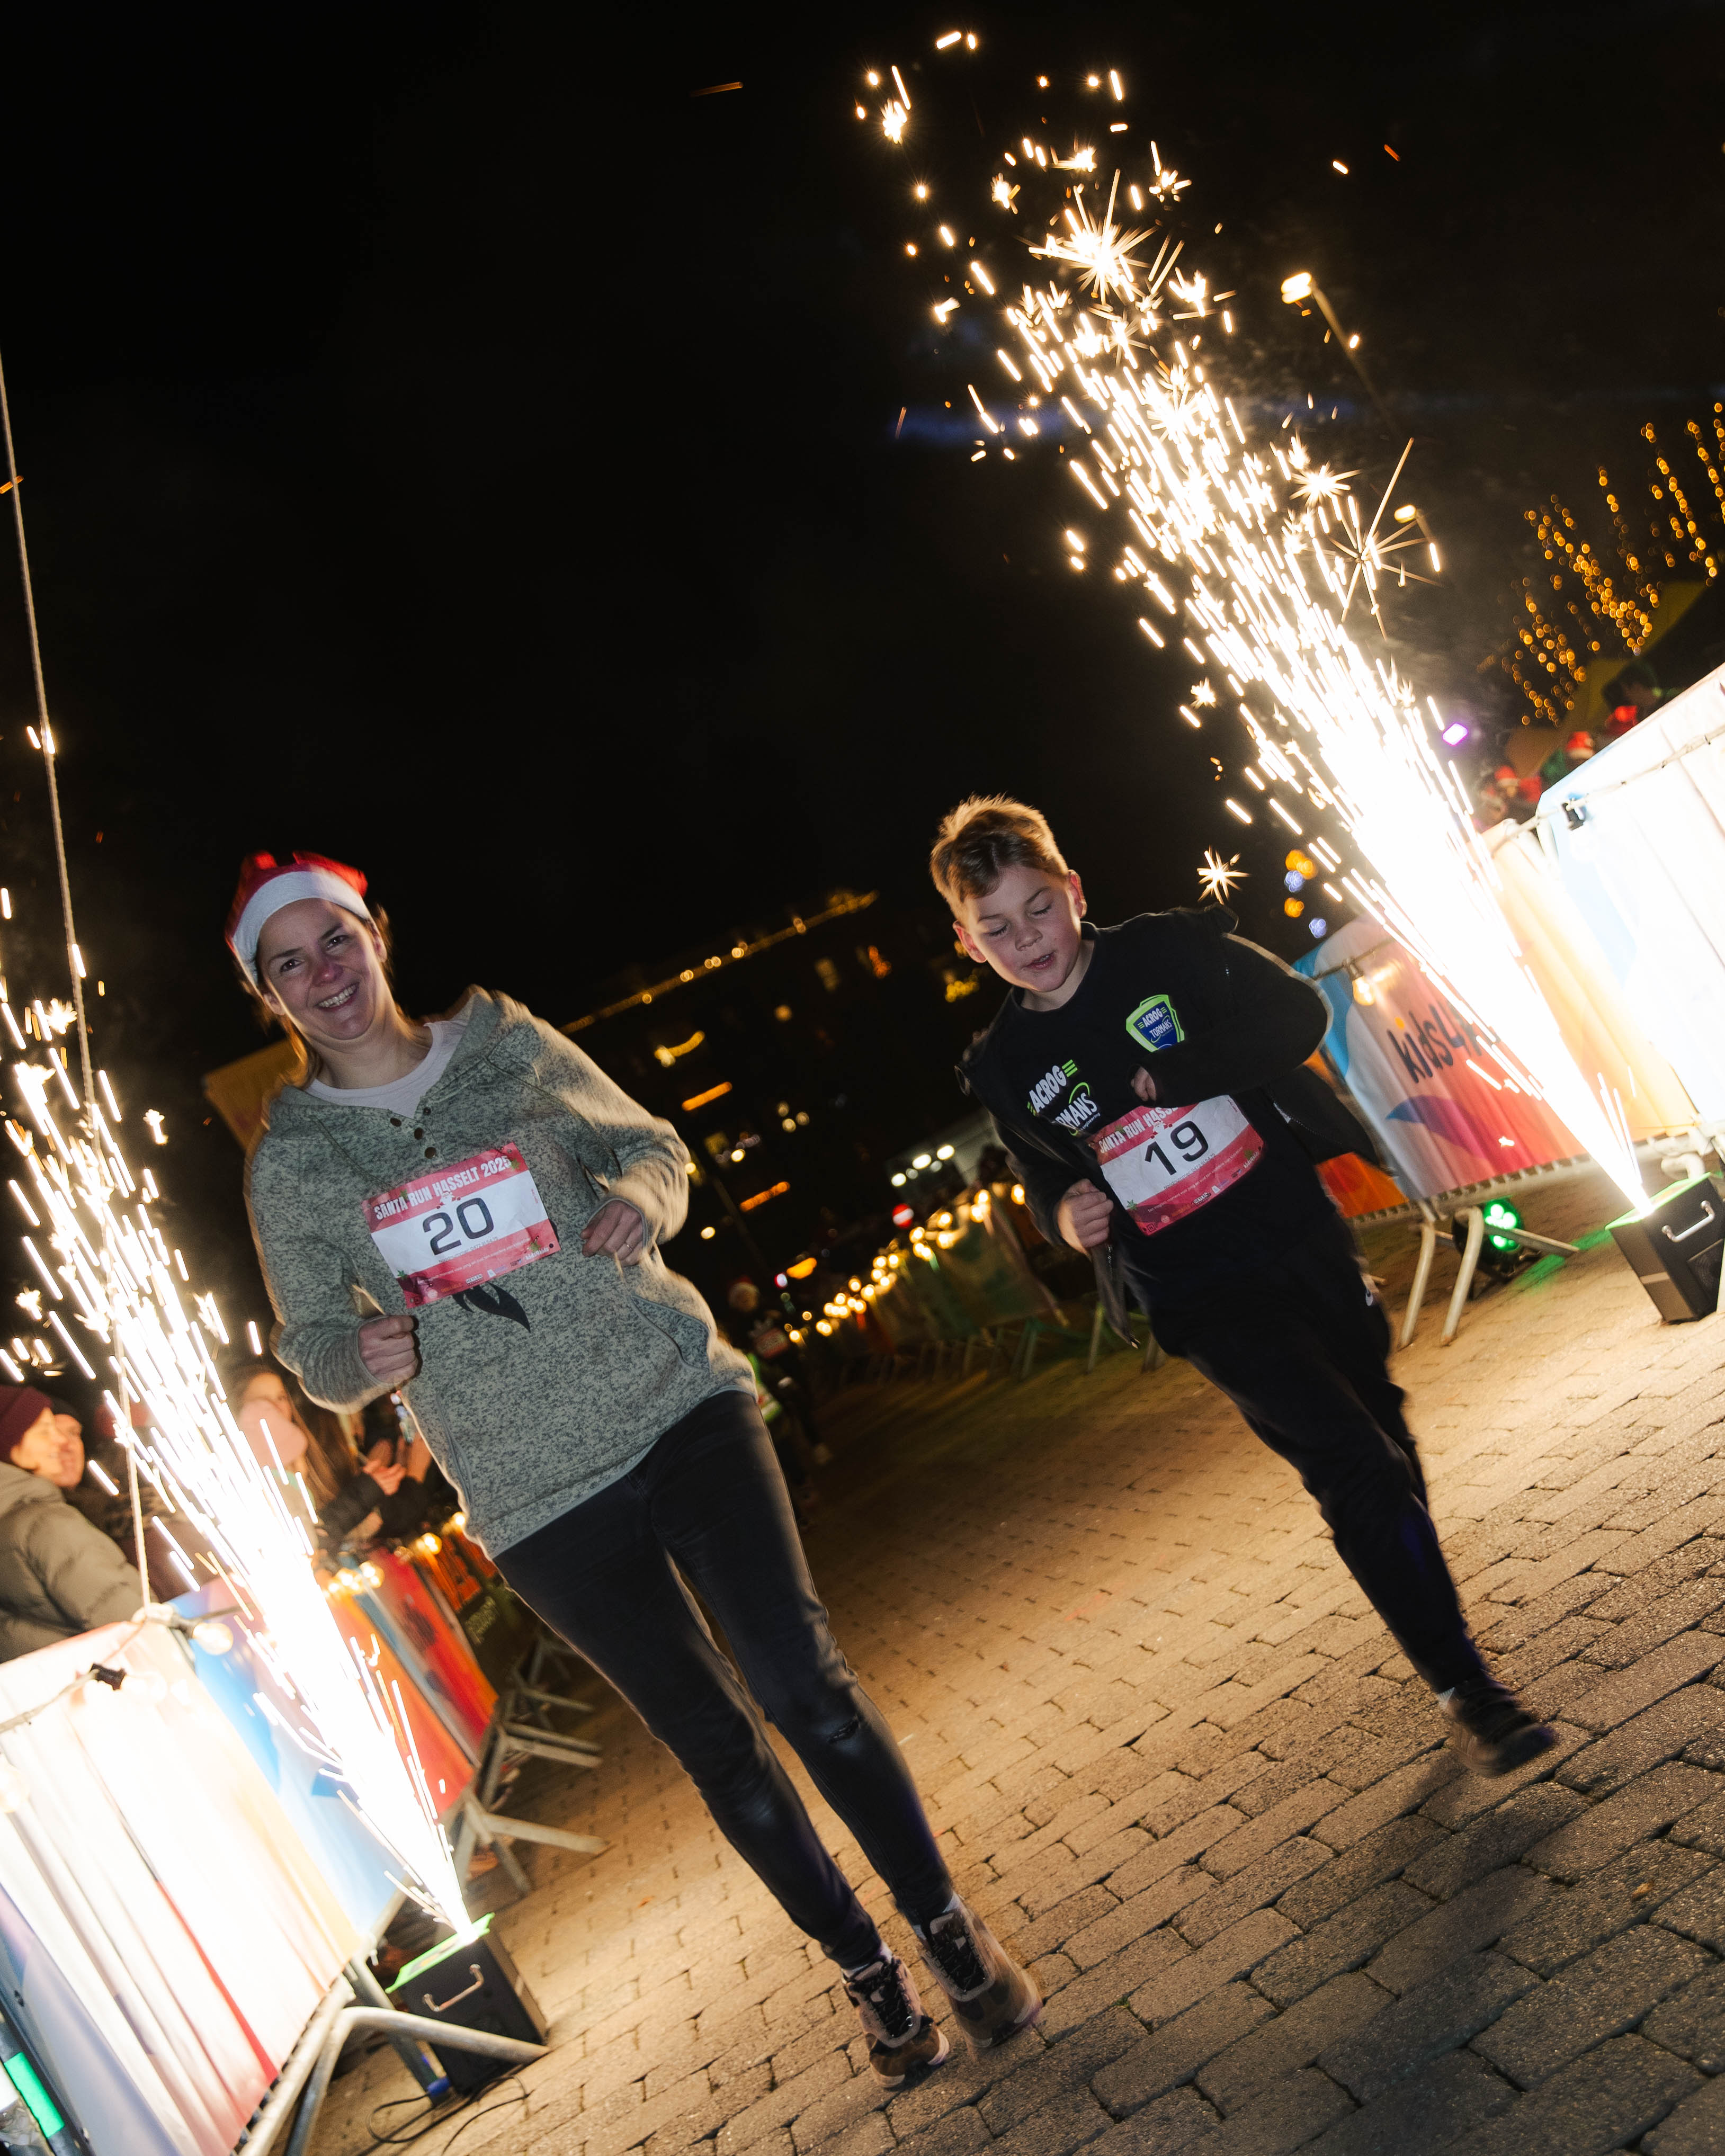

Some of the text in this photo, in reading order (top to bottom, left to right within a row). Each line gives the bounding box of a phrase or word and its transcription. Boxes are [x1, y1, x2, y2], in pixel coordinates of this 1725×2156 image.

[1142, 1008, 1163, 1027] ACROG
[1149, 1019, 1172, 1038] TORMANS
[1029, 1065, 1067, 1113] ACROG
[1098, 1107, 1178, 1153] SANTA RUN HASS
[1144, 1120, 1209, 1176] 19
[374, 1156, 512, 1220] SANTA RUN HASSELT 2025
[423, 1197, 494, 1255] 20
